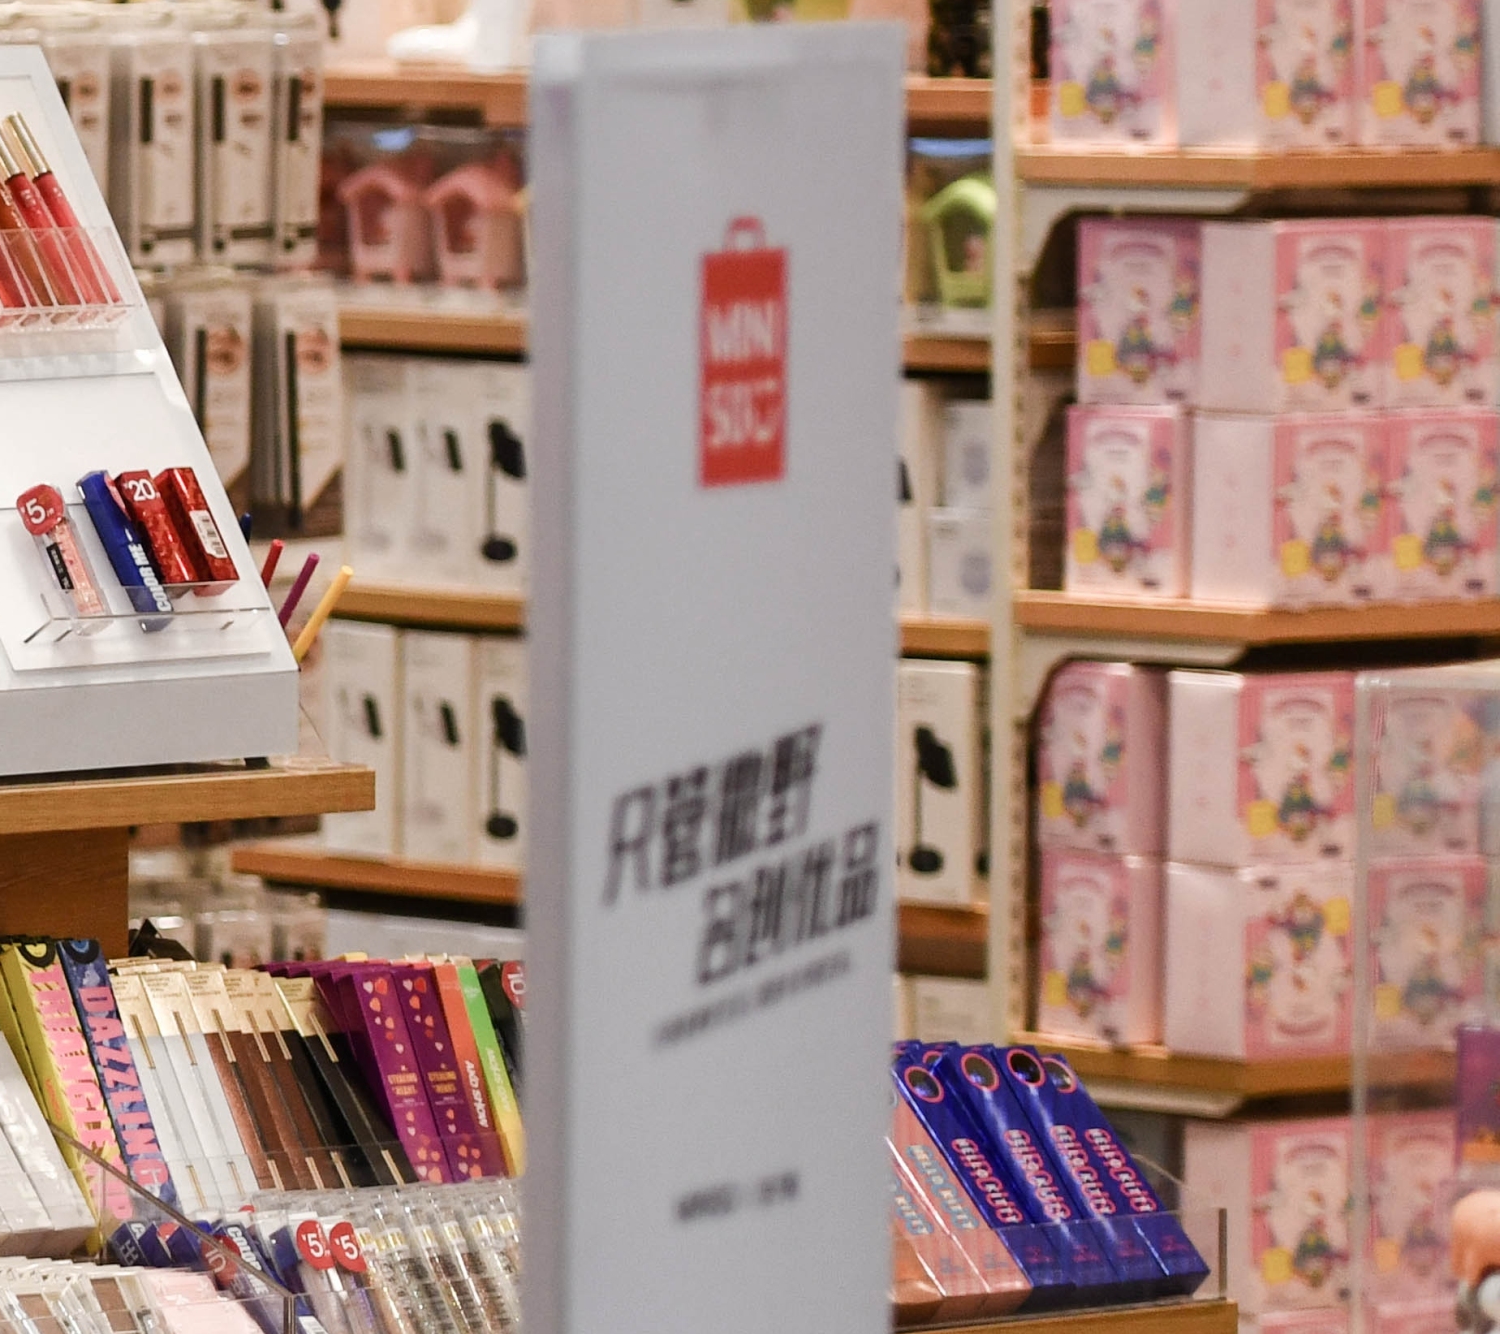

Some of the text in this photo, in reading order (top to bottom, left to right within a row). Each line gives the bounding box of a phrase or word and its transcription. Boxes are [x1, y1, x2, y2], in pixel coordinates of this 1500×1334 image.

[78, 986, 170, 1186] DAZZLING
[951, 1137, 1023, 1225] HELLO KITTY
[1004, 1129, 1072, 1220] HELLO KITTY
[1052, 1124, 1117, 1216] HELLO KITTY
[1084, 1127, 1157, 1214] HELLO KITTY
